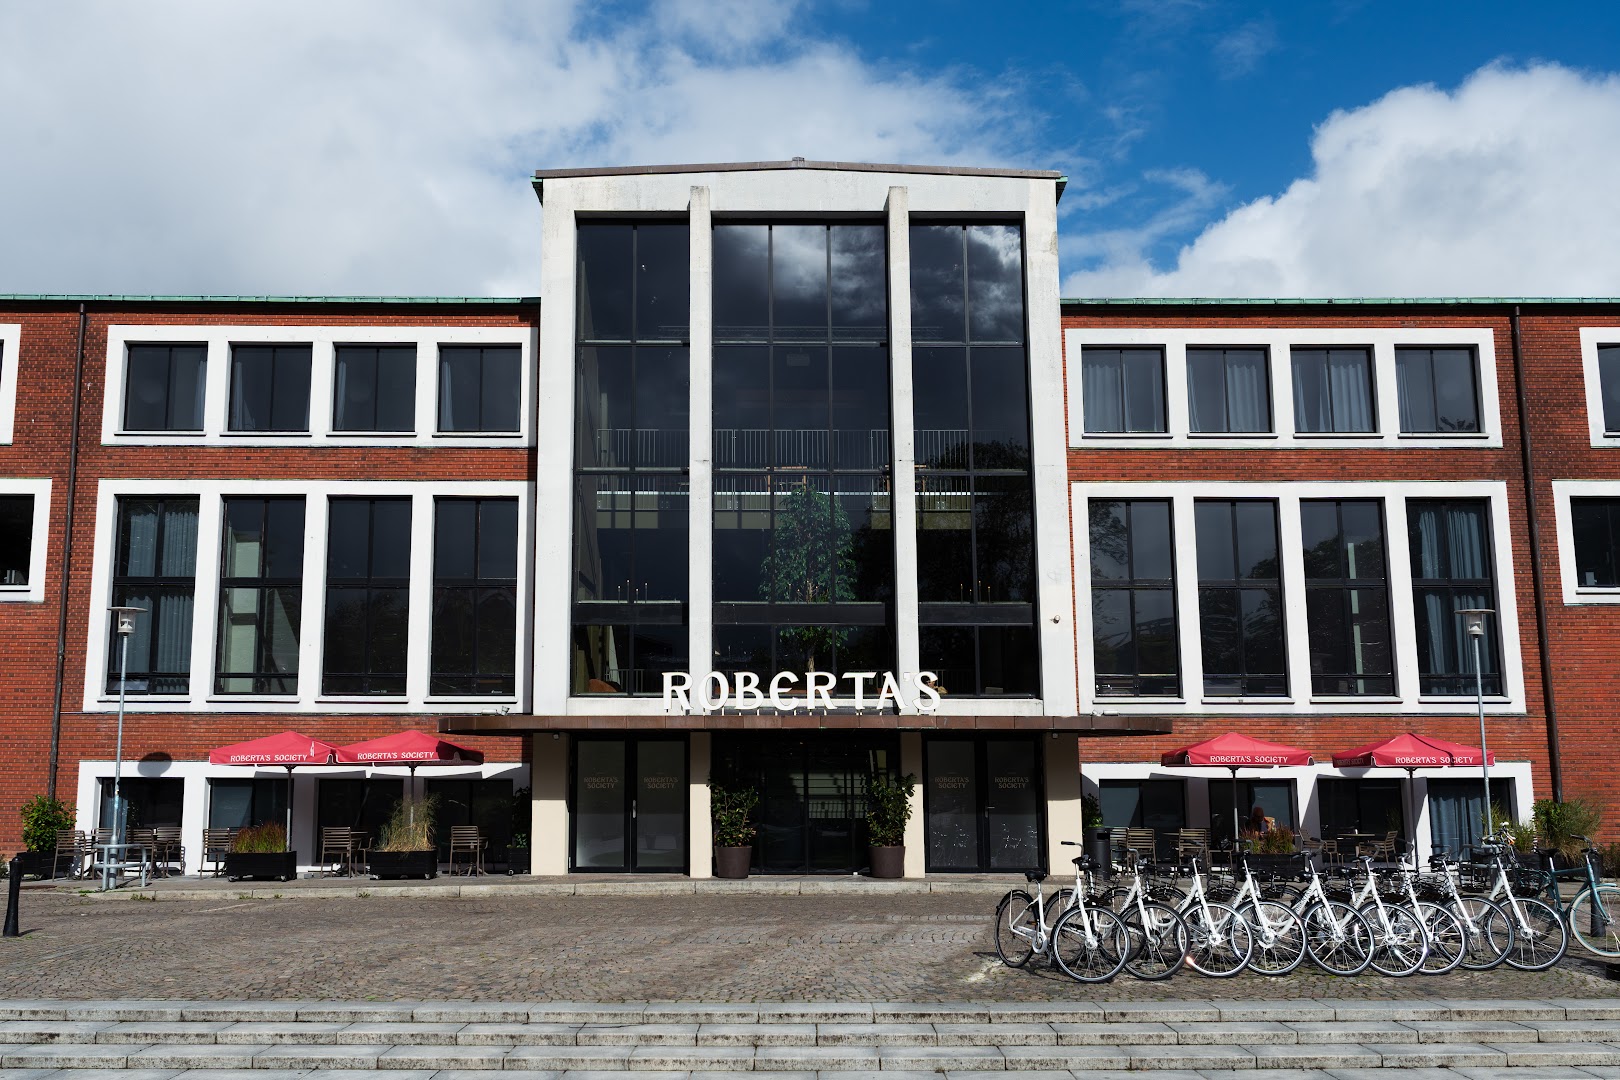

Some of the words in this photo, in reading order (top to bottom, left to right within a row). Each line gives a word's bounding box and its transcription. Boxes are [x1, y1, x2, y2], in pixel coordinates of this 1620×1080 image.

[662, 671, 941, 711] ROBERTA'S
[230, 754, 271, 763] ROBERTA'S
[274, 754, 308, 762] SOCIETY
[357, 752, 398, 761] ROBERTA'S
[401, 751, 434, 759] SOCIETY
[1209, 755, 1251, 763] ROBERTA'S
[1254, 755, 1288, 763] SOCIETY
[1395, 756, 1437, 764] ROBERTA'S
[1440, 756, 1473, 764] SOCIETY
